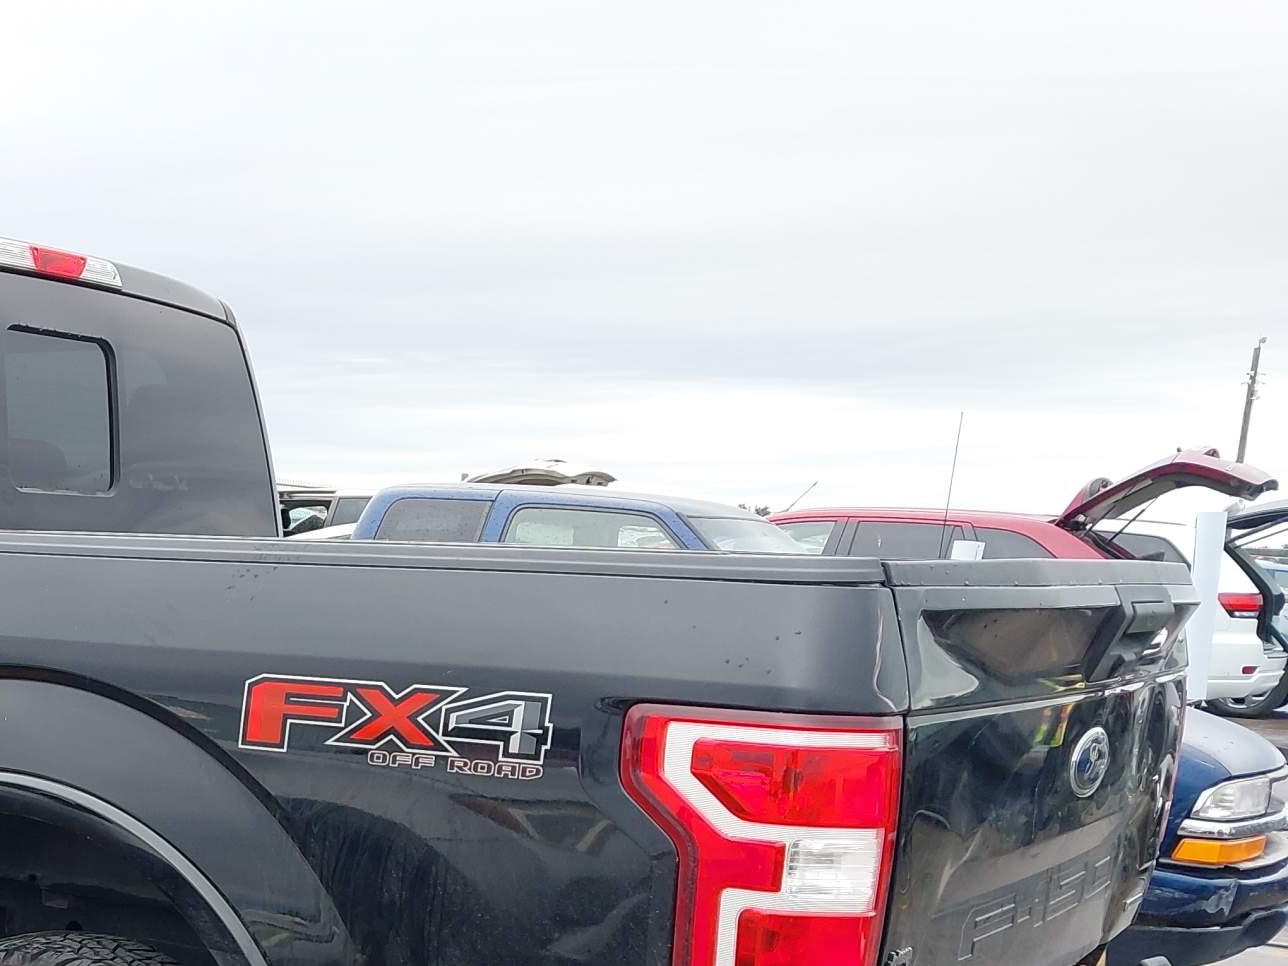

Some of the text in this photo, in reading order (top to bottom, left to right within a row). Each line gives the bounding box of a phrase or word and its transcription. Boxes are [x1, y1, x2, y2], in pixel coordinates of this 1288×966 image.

[239, 673, 553, 764] FX4
[367, 750, 544, 780] OFF ROAD
